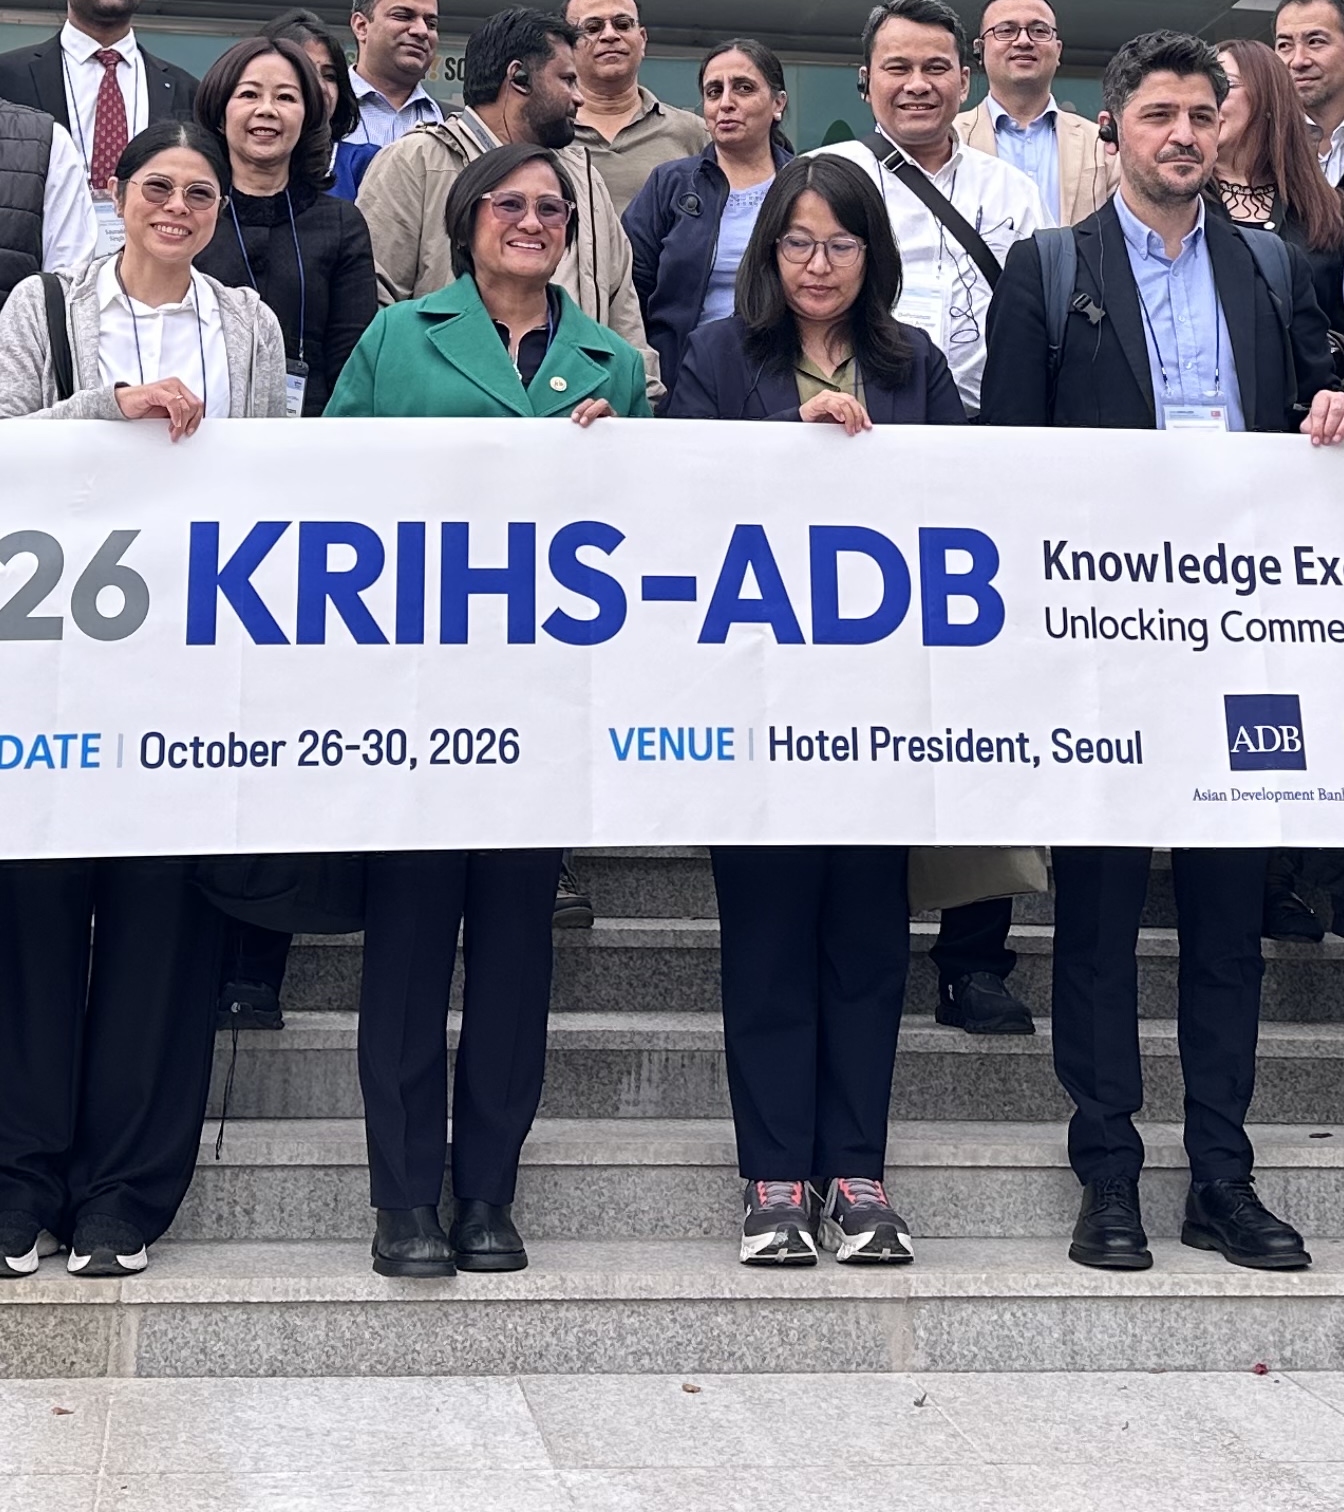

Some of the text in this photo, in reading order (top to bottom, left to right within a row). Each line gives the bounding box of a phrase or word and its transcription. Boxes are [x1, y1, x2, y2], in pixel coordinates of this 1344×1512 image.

[186, 521, 1005, 646] KRIHS-ADB
[1044, 540, 1281, 596] Knowledge
[1046, 607, 1208, 651] Unlocking
[141, 732, 286, 769] October
[298, 729, 417, 770] 26-30,
[430, 728, 519, 764] 2026
[609, 726, 1142, 768] VENUE Hotel President, Seoul
[1231, 725, 1302, 753] ADB
[1193, 788, 1227, 801] Asian
[1231, 787, 1314, 802] Development
